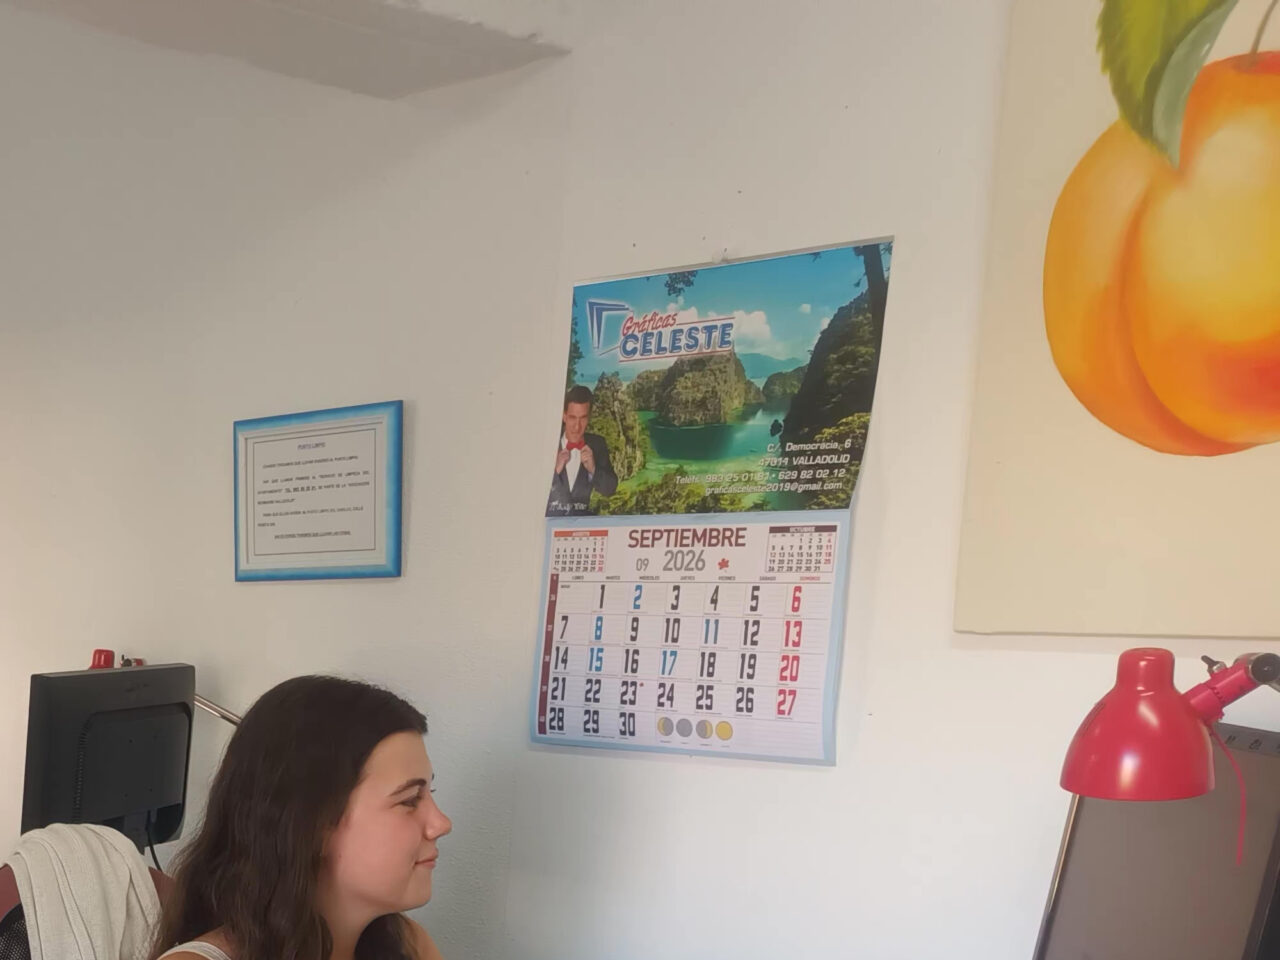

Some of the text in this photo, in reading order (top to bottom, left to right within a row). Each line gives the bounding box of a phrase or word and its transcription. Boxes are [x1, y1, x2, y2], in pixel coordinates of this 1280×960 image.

[622, 312, 677, 336] Gráficas
[621, 323, 734, 357] CELESTE
[844, 439, 851, 448] 6
[793, 455, 850, 464] VALLADOLID
[778, 471, 798, 480] 629
[800, 470, 813, 478] 82
[816, 469, 829, 478] 02
[833, 469, 845, 477] 12
[628, 528, 747, 548] SEPTIEMBRE
[636, 550, 705, 571] 09 2026
[599, 584, 802, 612] 1 2 3 4 5 6
[560, 616, 802, 647] 7 8 9 10 11 12 13
[554, 647, 800, 681] 14 15 16 17 18 19 20
[551, 677, 796, 715] 21 22 23 24 25 26 27
[549, 707, 635, 736] 28 29 30
